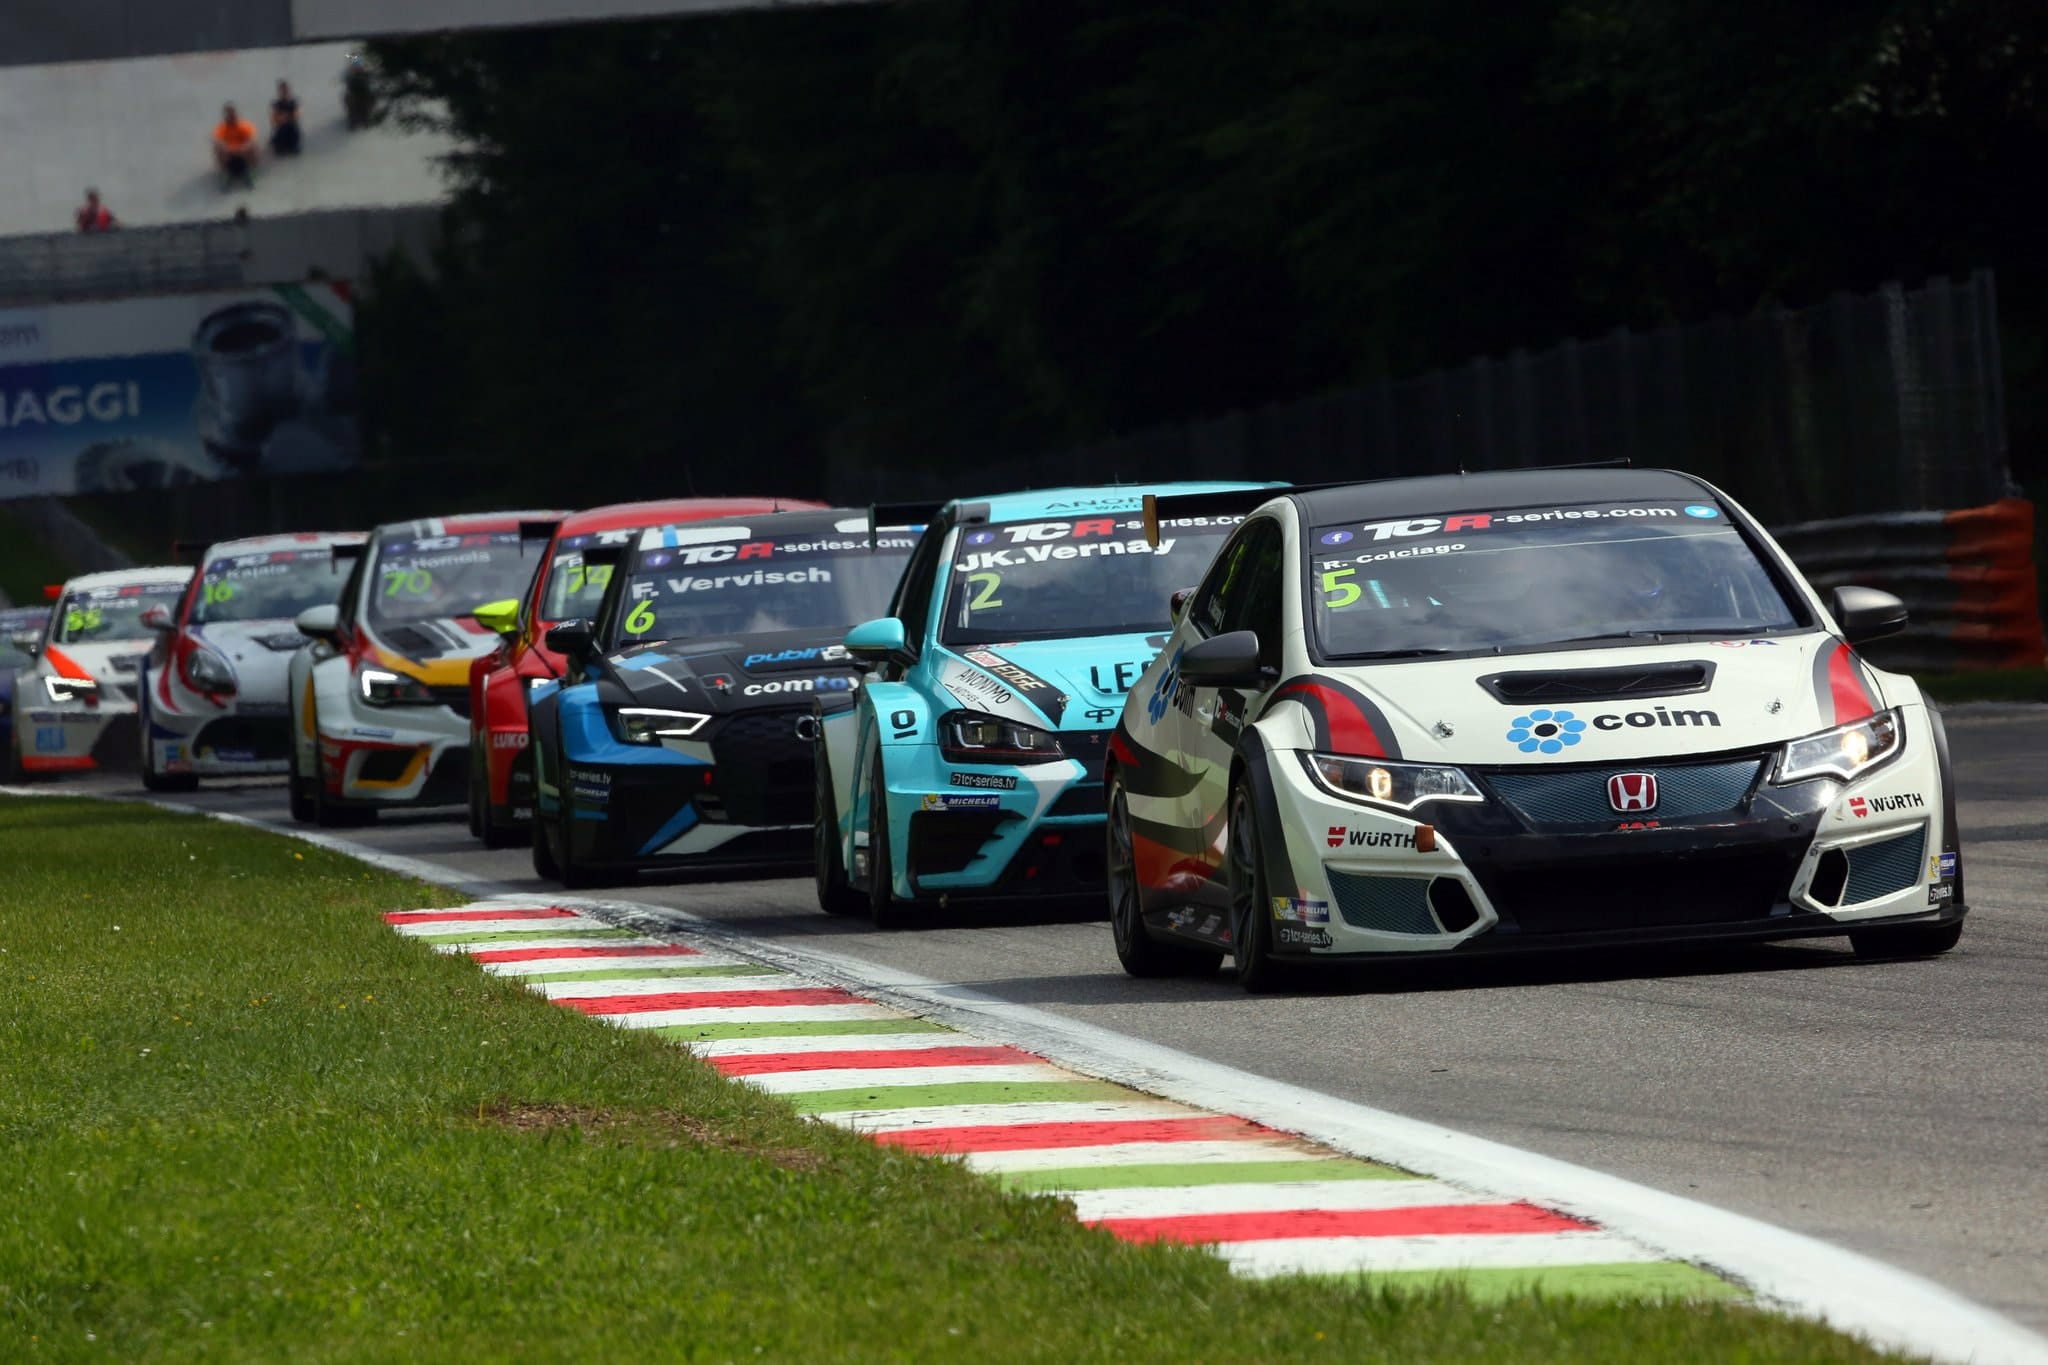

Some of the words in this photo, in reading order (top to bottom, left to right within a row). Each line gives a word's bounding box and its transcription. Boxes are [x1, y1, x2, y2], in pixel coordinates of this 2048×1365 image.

[1004, 516, 1246, 543] TCR-sries.c
[1364, 506, 1677, 540] TCR-series.com
[1323, 560, 1348, 571] R.
[1356, 543, 1466, 564] Colciago
[205, 579, 233, 605] 16
[384, 569, 432, 598] 70
[632, 582, 659, 600] F.
[667, 568, 832, 594] Vervisch
[968, 572, 1003, 610] 2
[1321, 568, 1362, 608] 5
[625, 600, 656, 634] 6
[955, 669, 1012, 704] ANONIMO
[992, 665, 1048, 691] EDGE
[1593, 706, 1721, 731] coim
[962, 774, 1015, 789] tcr-series.tv
[948, 797, 999, 806] MICHELIN
